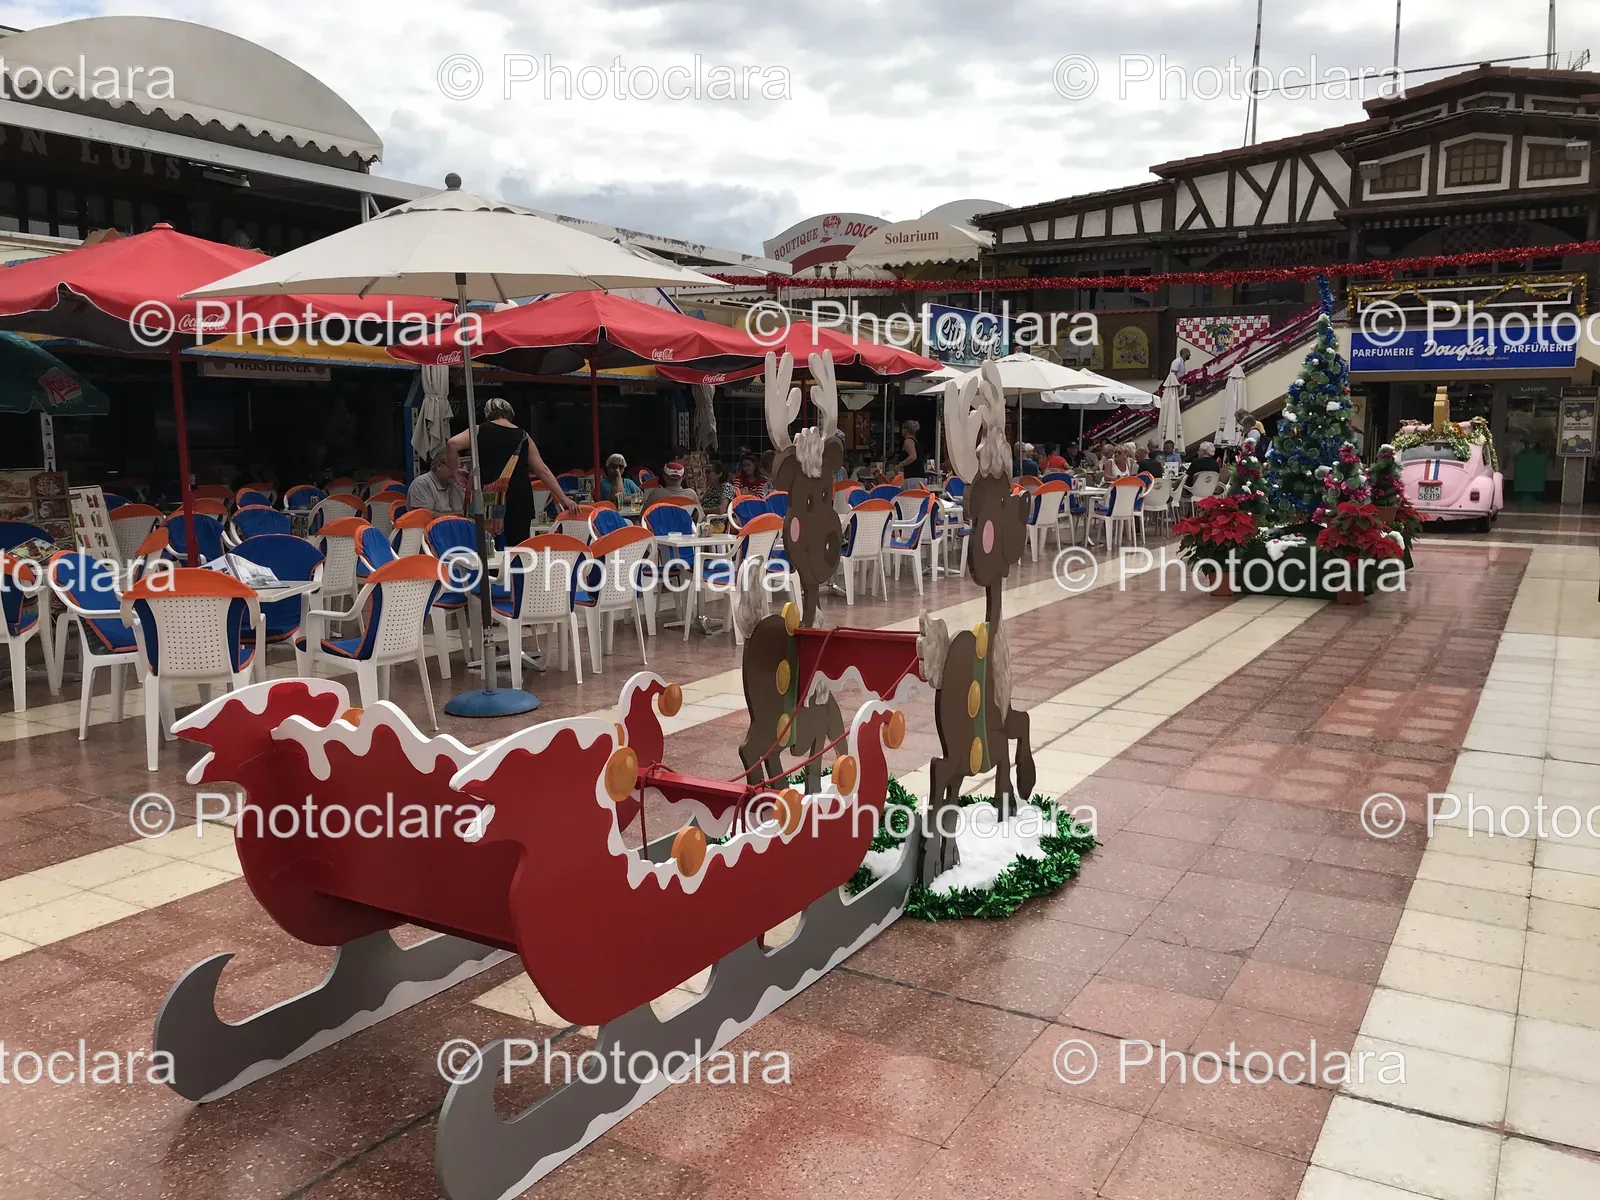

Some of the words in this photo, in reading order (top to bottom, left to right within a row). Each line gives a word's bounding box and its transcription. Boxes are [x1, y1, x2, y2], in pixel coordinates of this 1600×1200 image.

[774, 228, 818, 260] BOUTIQUE
[884, 230, 939, 244] Solarium
[178, 313, 228, 331] Coca-Cola
[938, 316, 966, 359] City
[1353, 346, 1414, 358] PARFÜMERIE
[1421, 336, 1498, 362] Douglas
[1503, 341, 1573, 353] PARFÜMERIE
